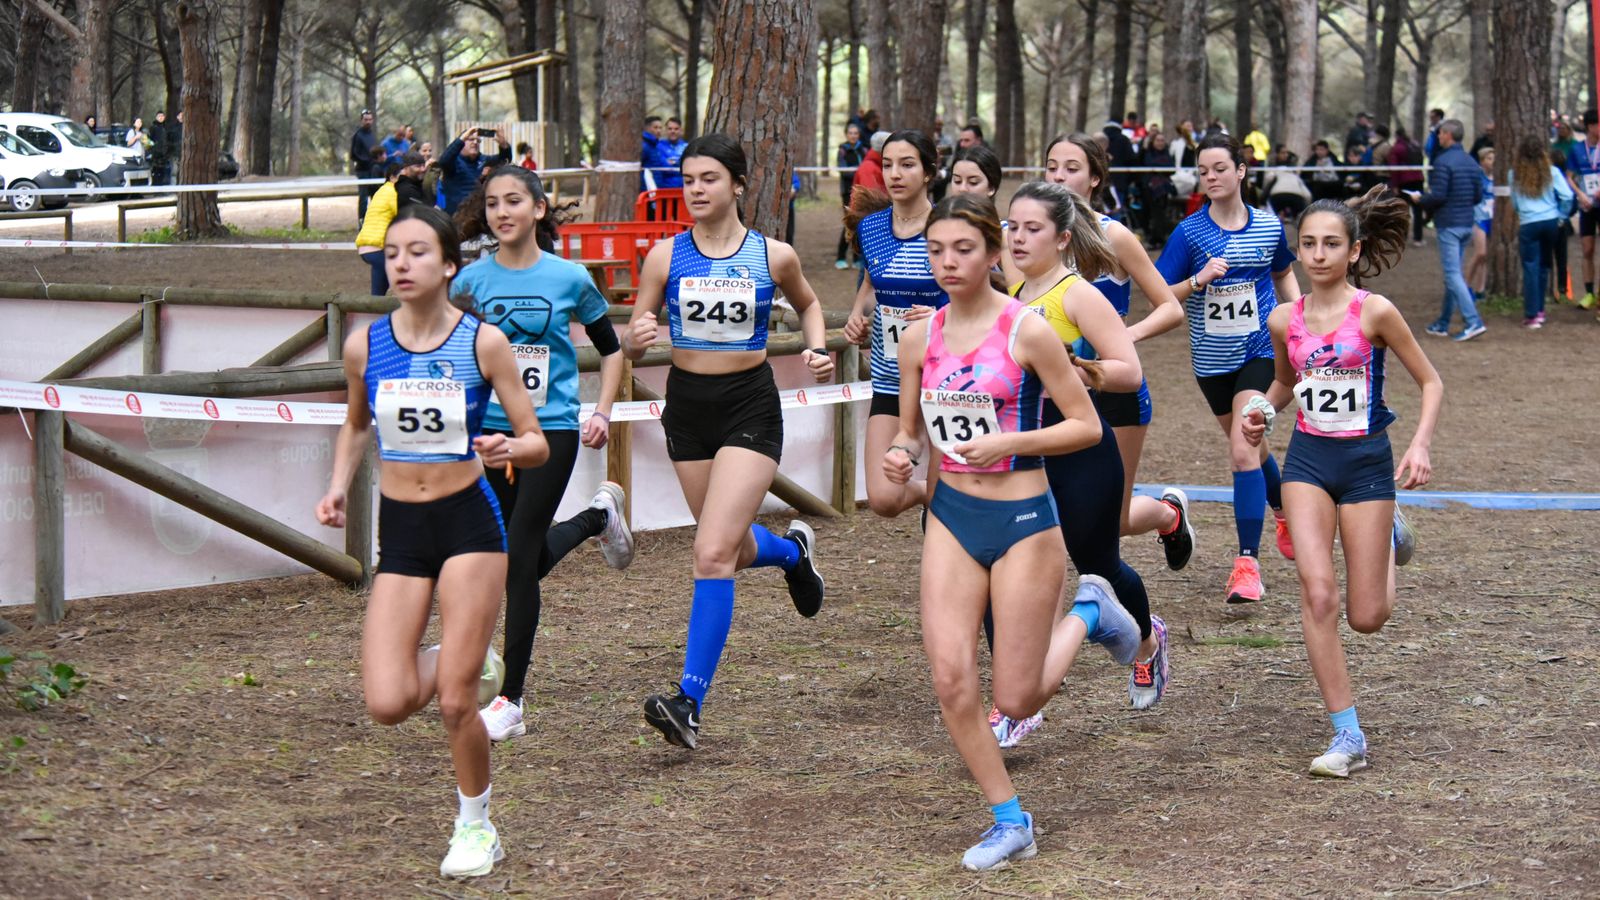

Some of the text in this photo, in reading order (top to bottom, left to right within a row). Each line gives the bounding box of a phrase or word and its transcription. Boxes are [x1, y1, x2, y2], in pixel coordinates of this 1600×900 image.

[686, 300, 748, 324] 243
[1208, 300, 1254, 320] 214
[1300, 388, 1356, 413] 121
[398, 408, 445, 433] 53
[932, 416, 990, 442] 131
